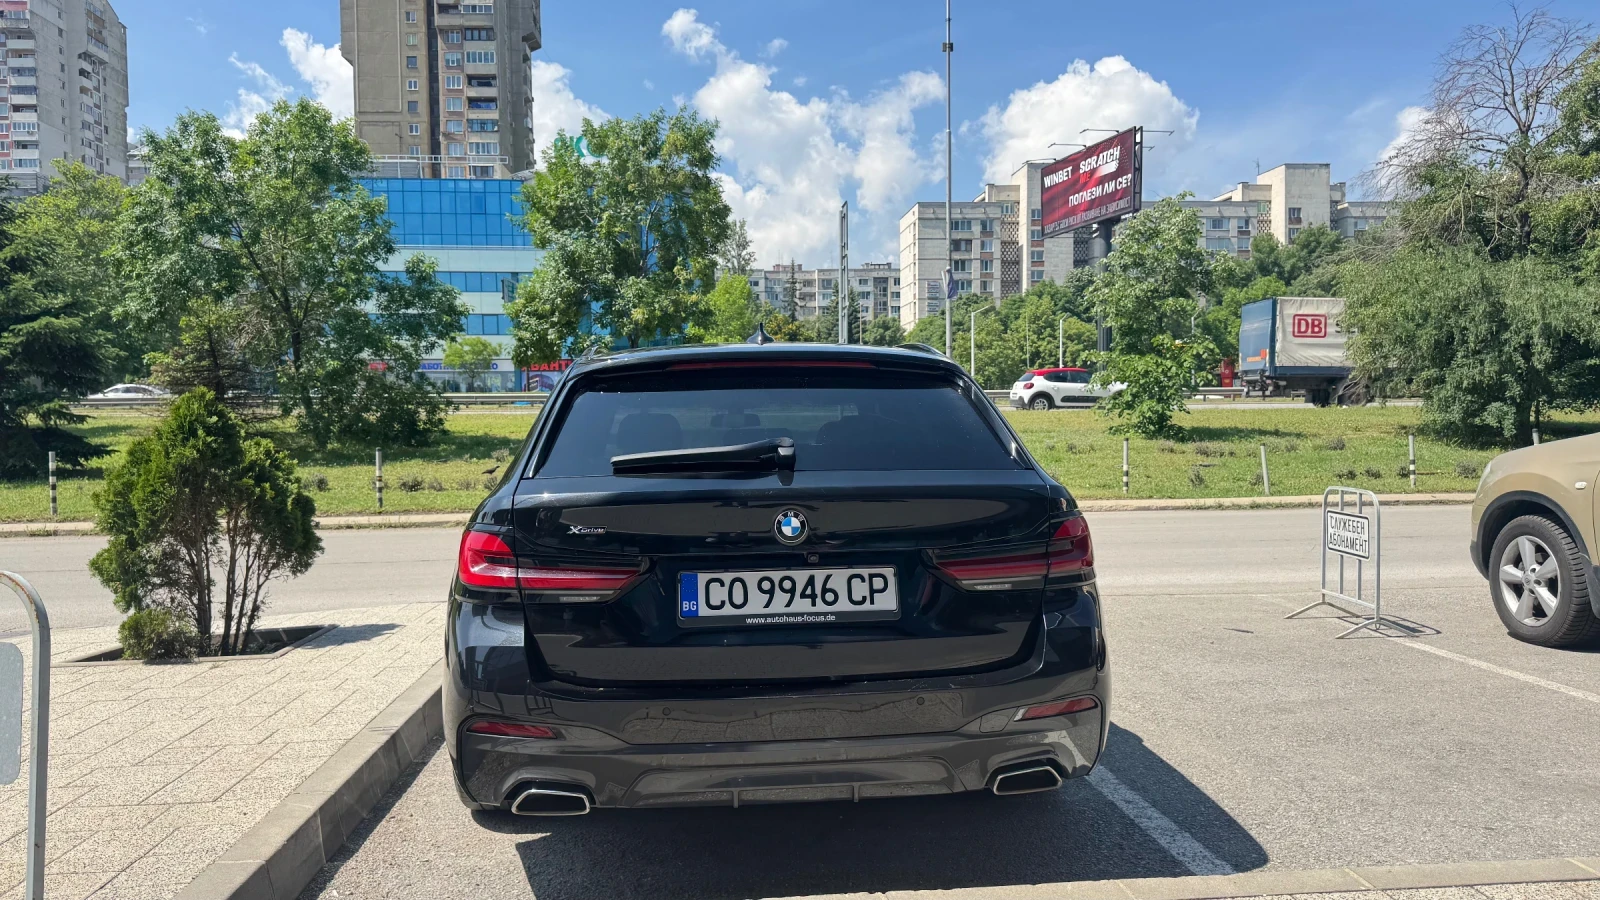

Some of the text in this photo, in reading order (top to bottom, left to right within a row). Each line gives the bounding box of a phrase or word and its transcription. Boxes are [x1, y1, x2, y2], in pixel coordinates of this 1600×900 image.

[1080, 146, 1121, 174] SCRATCH
[1043, 166, 1073, 188] WINBET
[1080, 171, 1091, 184] ME
[1068, 173, 1132, 208] ПОГЛЕЗИ ЛИ СЕ?
[1296, 318, 1323, 335] DB
[778, 511, 805, 522] BMW
[1329, 515, 1365, 535] СЛУЖЕБЕН
[1329, 532, 1368, 553] АБОНАМЕНТ
[704, 572, 889, 611] CO 9946 CP
[682, 600, 697, 611] BG
[745, 613, 836, 624] www.autohaus-focus.de
